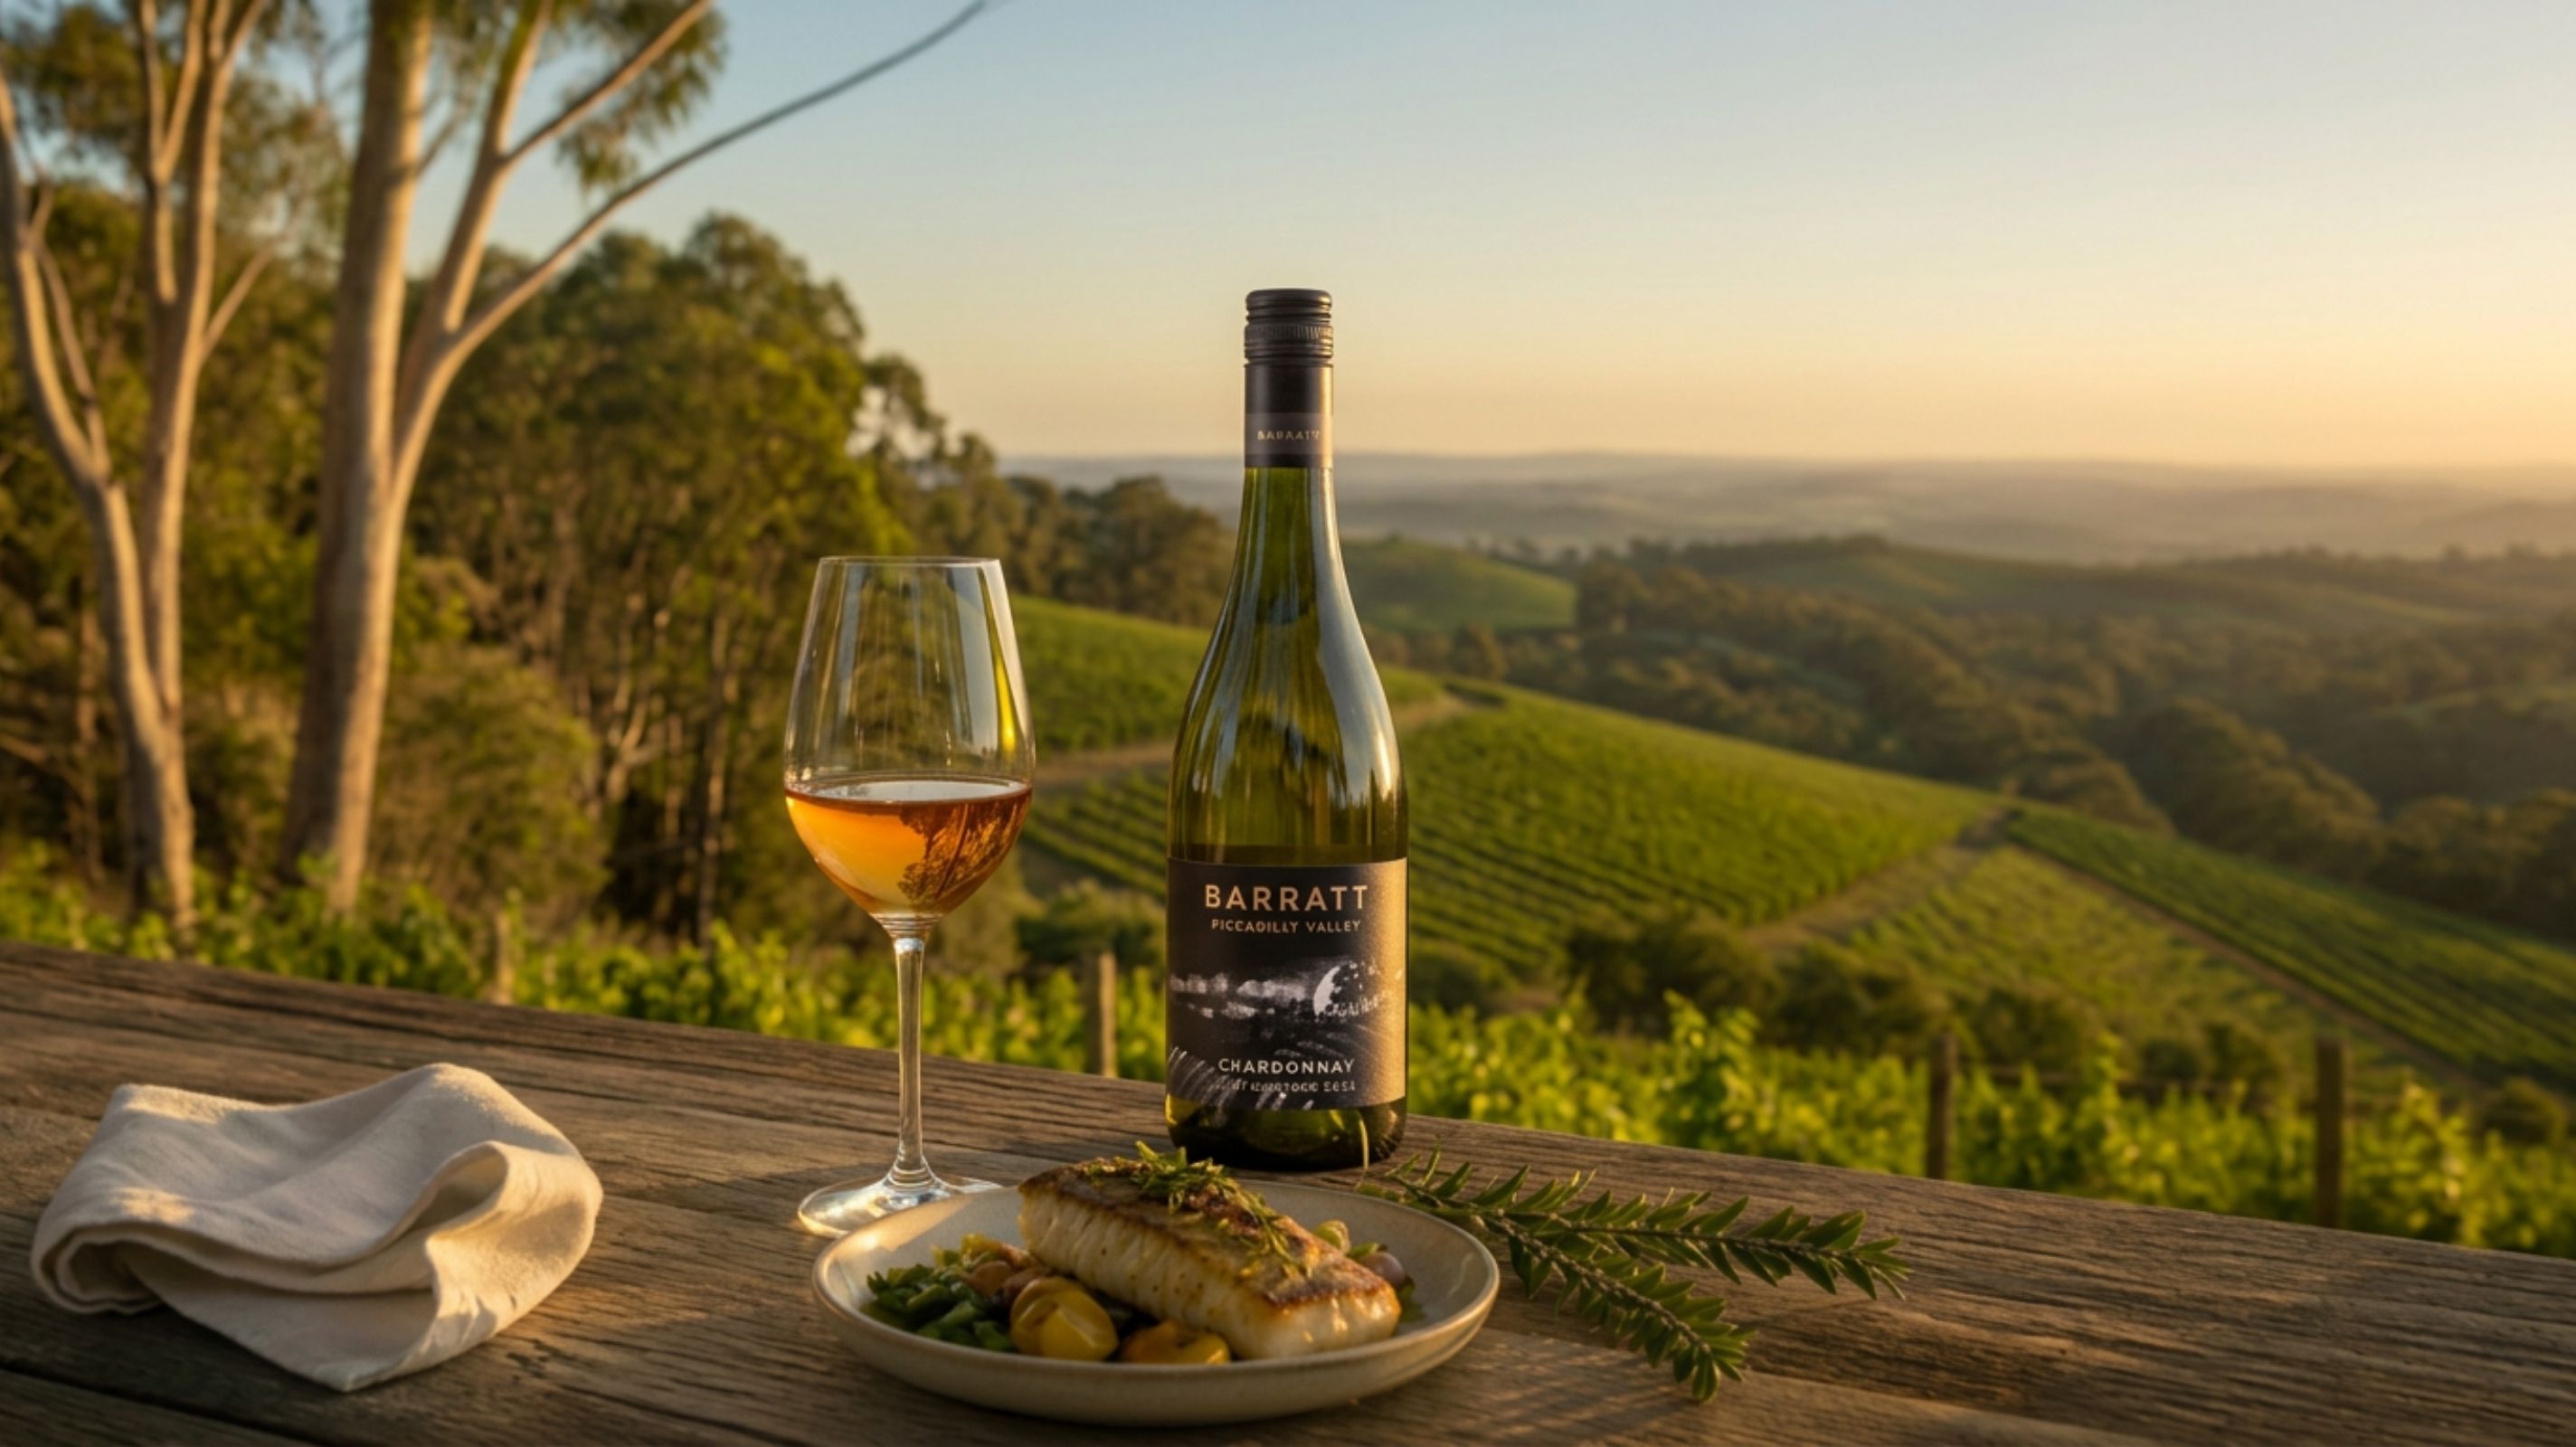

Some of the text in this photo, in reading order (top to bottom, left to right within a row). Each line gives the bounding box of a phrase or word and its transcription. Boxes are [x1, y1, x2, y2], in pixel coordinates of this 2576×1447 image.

[1205, 884, 1368, 911] BARRATT
[1211, 919, 1361, 933] PICCADILLY VALLEY
[1218, 1058, 1355, 1073] CHARDONNAY
